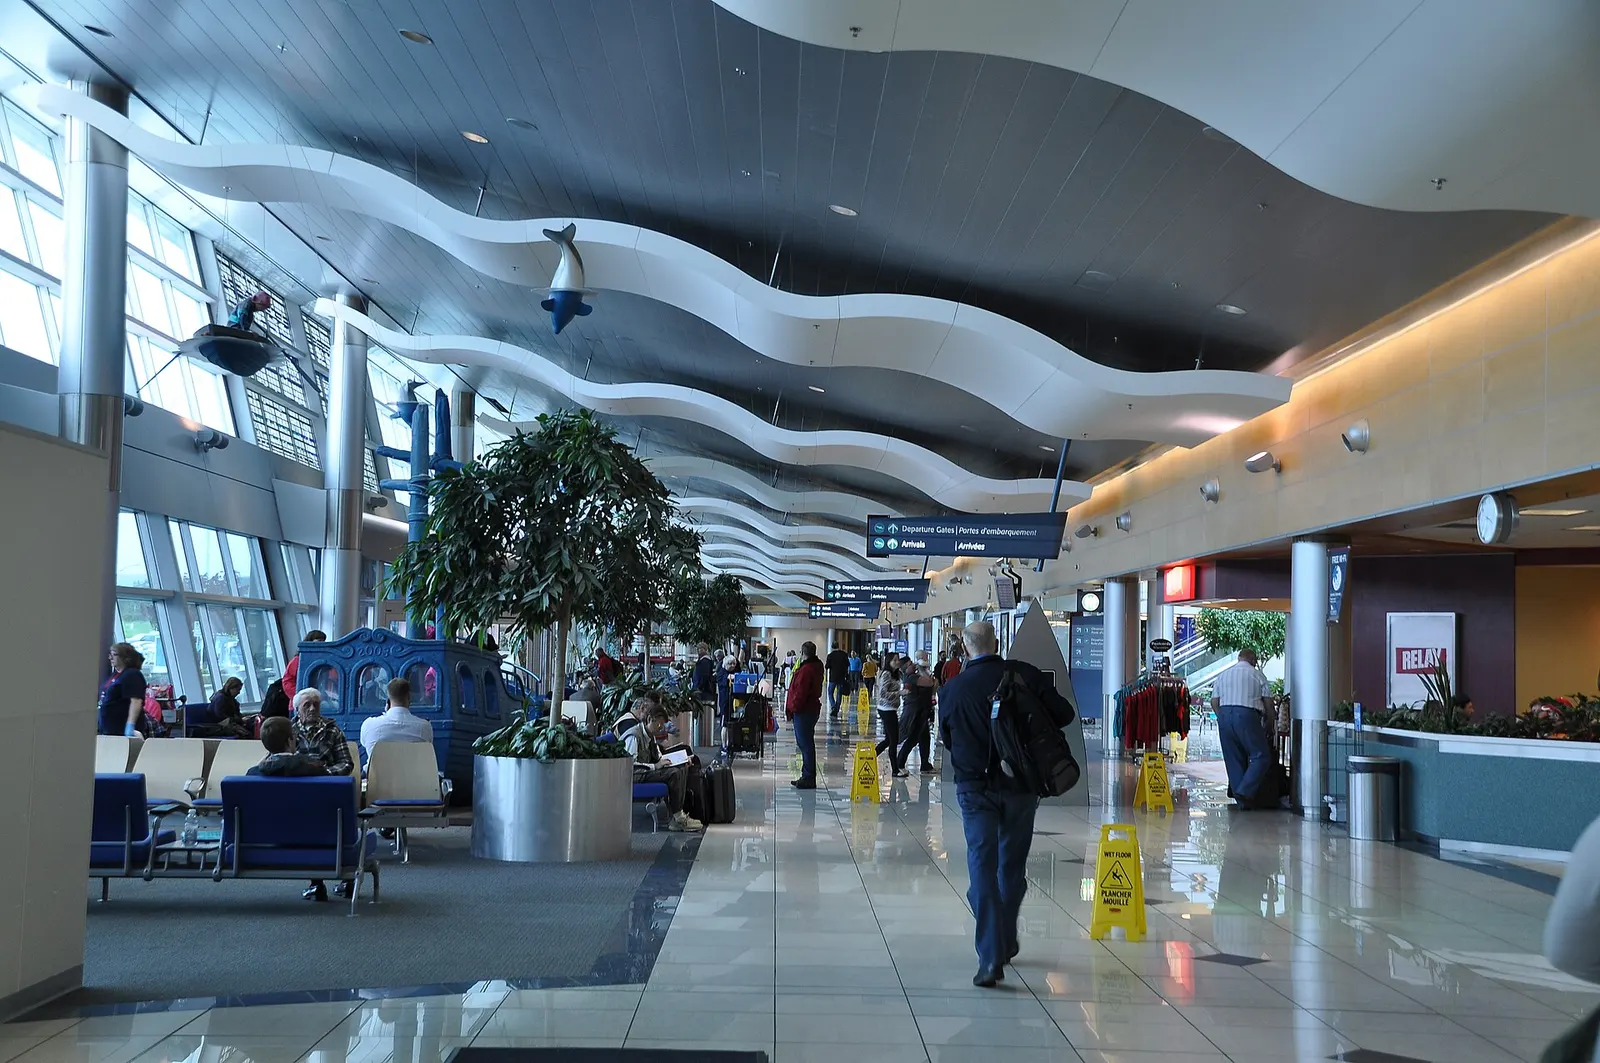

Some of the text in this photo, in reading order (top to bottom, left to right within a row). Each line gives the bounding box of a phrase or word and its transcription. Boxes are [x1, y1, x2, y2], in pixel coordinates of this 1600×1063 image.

[901, 525, 1037, 537] Departure Gates Portes d'embarquement
[901, 540, 985, 551] Arrivals Arrivées
[1402, 648, 1441, 670] RELAY
[1115, 851, 1132, 859] FLOOR
[1101, 890, 1132, 899] PLANCHER
[1103, 897, 1129, 906] MOUILLÉ
